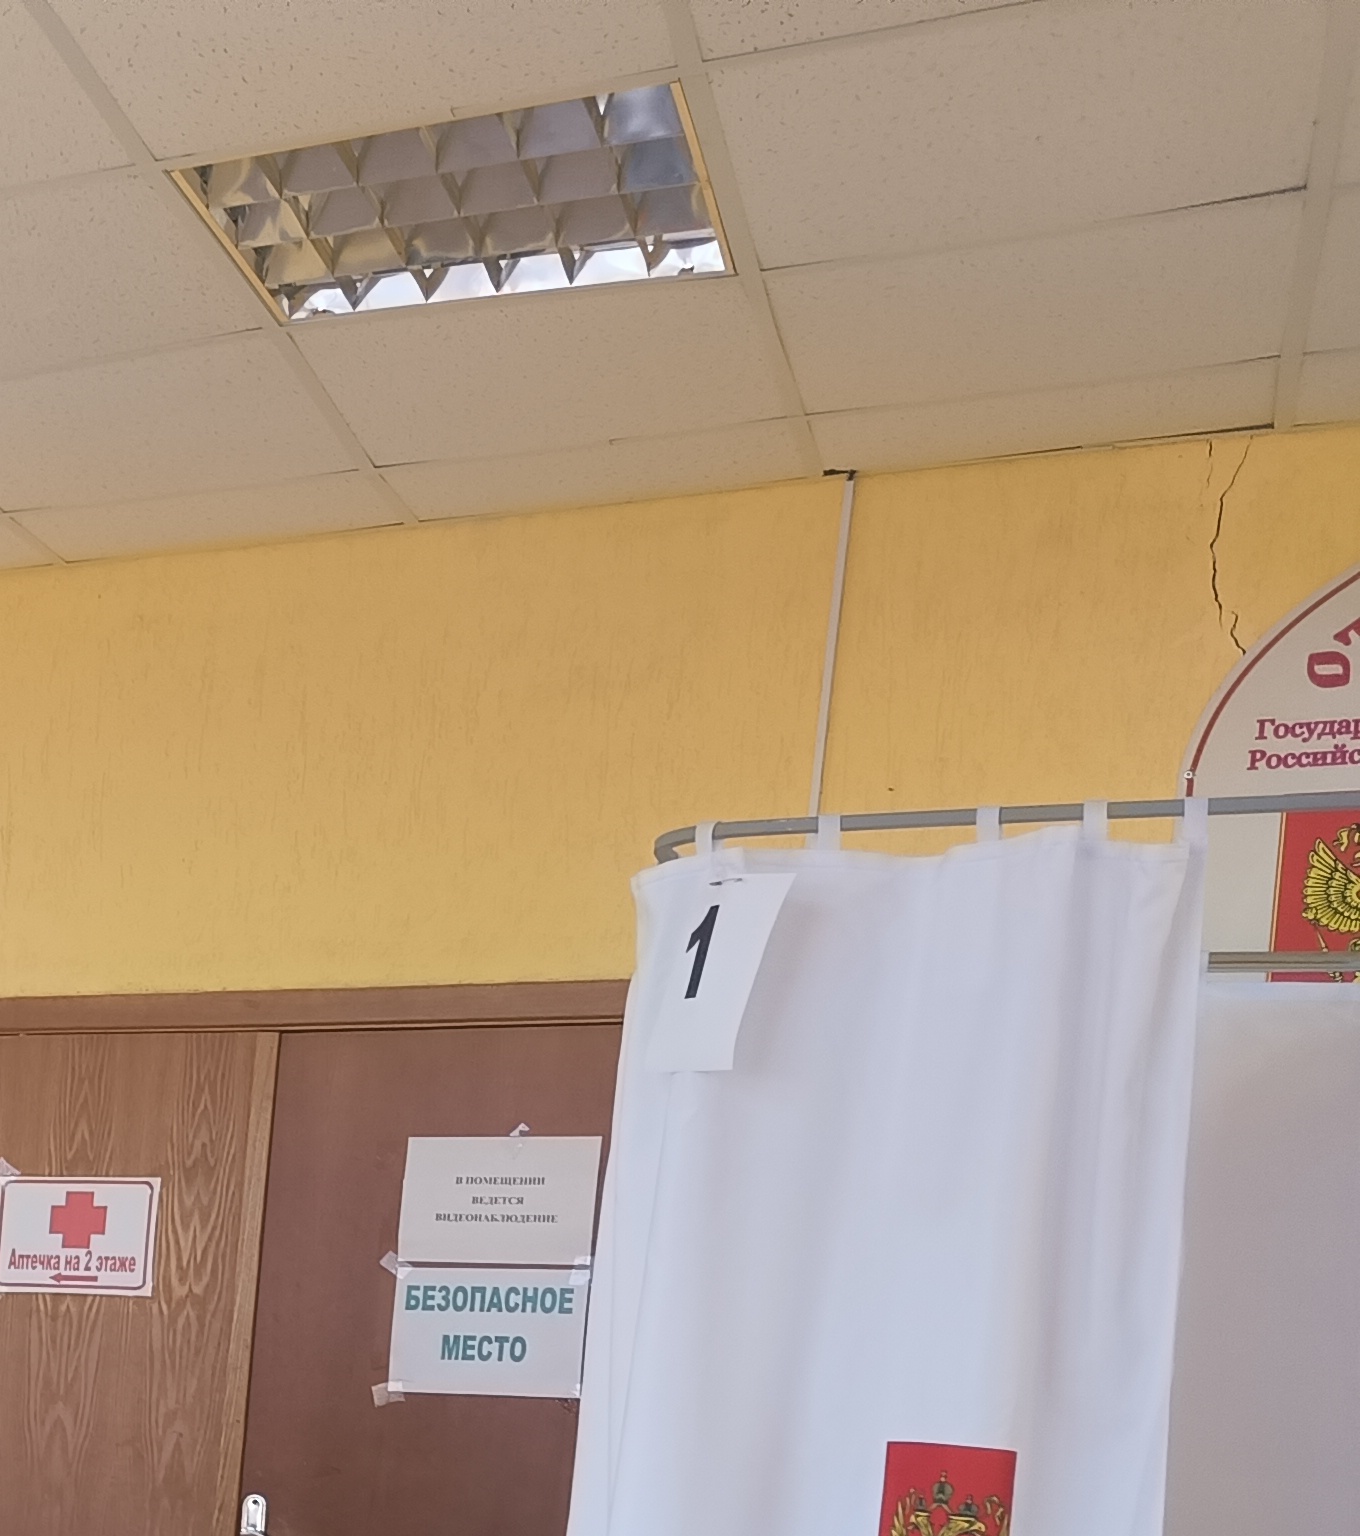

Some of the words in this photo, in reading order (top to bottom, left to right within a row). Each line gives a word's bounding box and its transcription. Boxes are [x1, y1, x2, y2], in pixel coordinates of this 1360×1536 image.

[1247, 743, 1360, 770] Российс
[684, 904, 720, 999] 1
[455, 1177, 463, 1185] В
[465, 1177, 546, 1187] ПОМЕЩЕНИИ
[471, 1196, 525, 1206] ВЕДЕТСЯ
[435, 1213, 559, 1224] ВИДЕОНАБЛЮДЕНИЕ
[8, 1248, 61, 1271] Аптечка
[64, 1254, 80, 1271] на
[83, 1250, 93, 1272] 2
[96, 1255, 137, 1273] этаже
[405, 1285, 575, 1314] БЕЗОПАСНОЕ
[440, 1334, 527, 1362] МЕСТО
